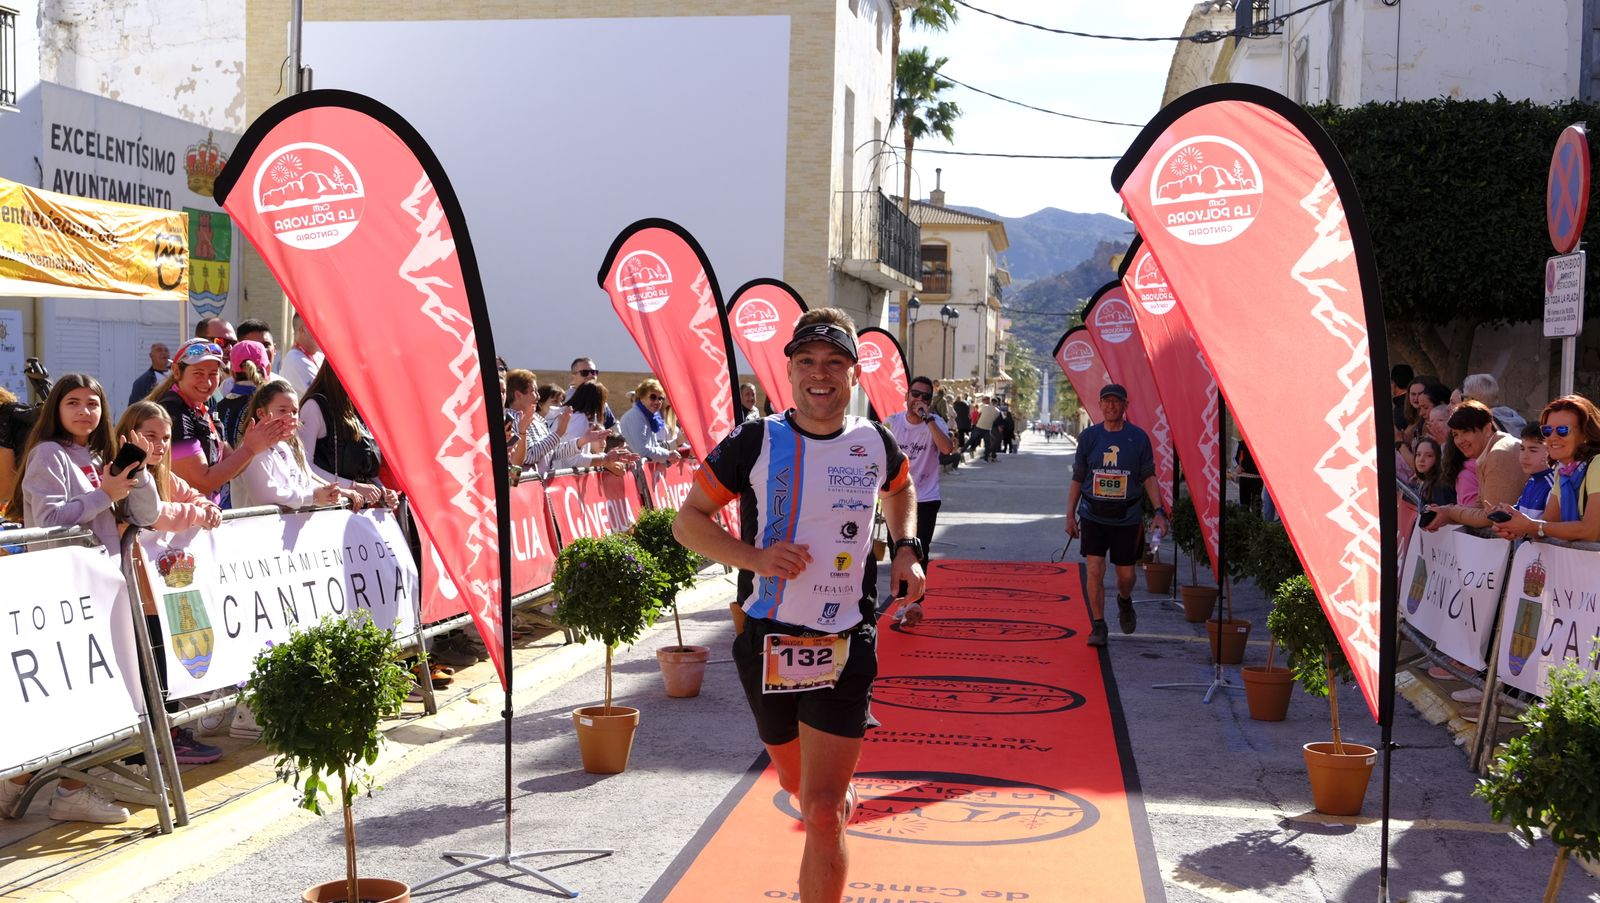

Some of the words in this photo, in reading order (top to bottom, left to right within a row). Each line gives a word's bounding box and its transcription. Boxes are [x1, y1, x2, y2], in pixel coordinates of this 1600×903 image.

[51, 123, 175, 176] EXCELENTÍSIMO
[53, 168, 172, 210] AYUNTAMIENTO
[828, 466, 864, 476] PARQUE
[828, 475, 877, 487] TROPICAL
[1100, 479, 1120, 488] 668
[219, 545, 368, 585] AYUNTAMIENTO
[377, 540, 397, 559] DE
[223, 566, 408, 639] CANTORIA
[9, 605, 45, 635] TO
[61, 595, 94, 625] DE
[780, 648, 833, 667] 132
[11, 632, 114, 703] RIA
[874, 731, 993, 741] Cantoria
[854, 783, 997, 798] POLVOR
[848, 881, 967, 898] Canto
[981, 890, 1030, 901] de
